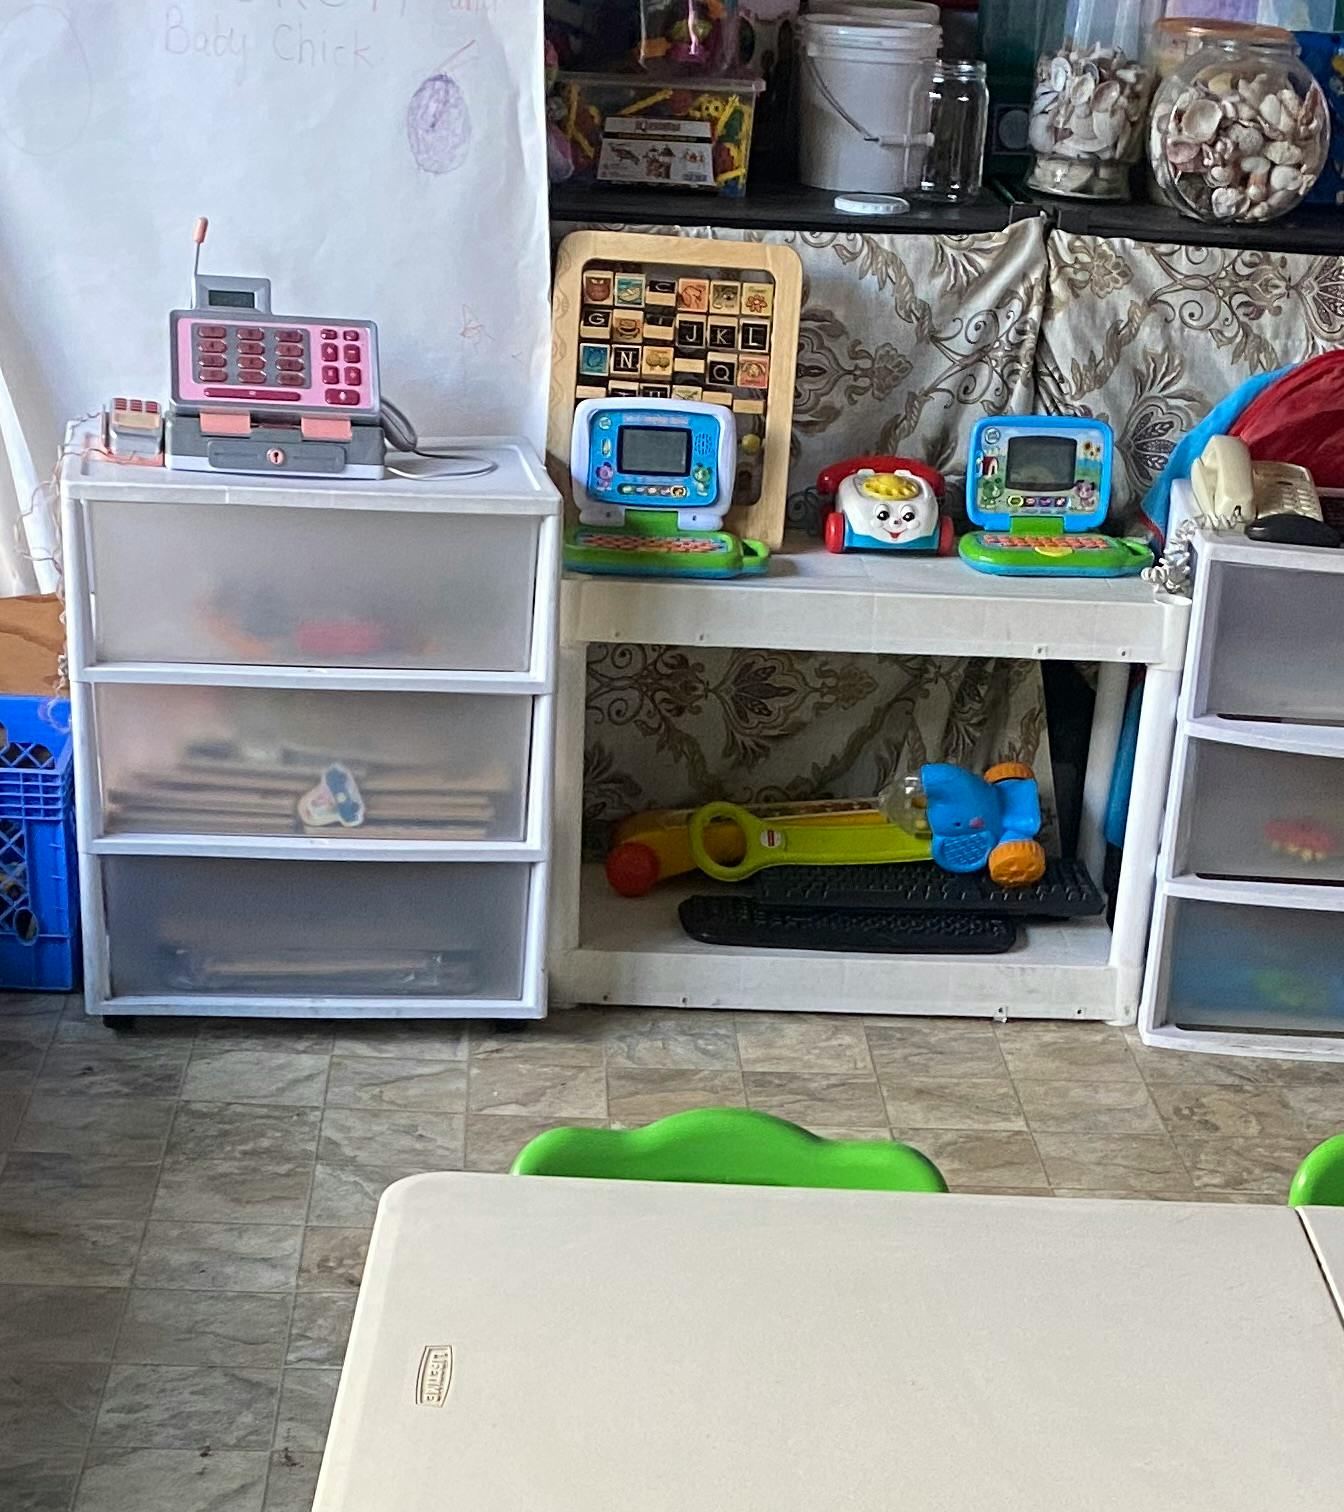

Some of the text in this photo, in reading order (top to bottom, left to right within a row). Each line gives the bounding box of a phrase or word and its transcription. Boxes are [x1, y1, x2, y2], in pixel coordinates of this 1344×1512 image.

[271, 22, 375, 68] Chick
[588, 312, 606, 326] G
[685, 324, 697, 342] J
[716, 329, 728, 345] K
[748, 327, 759, 346] L
[620, 351, 731, 382] N Q
